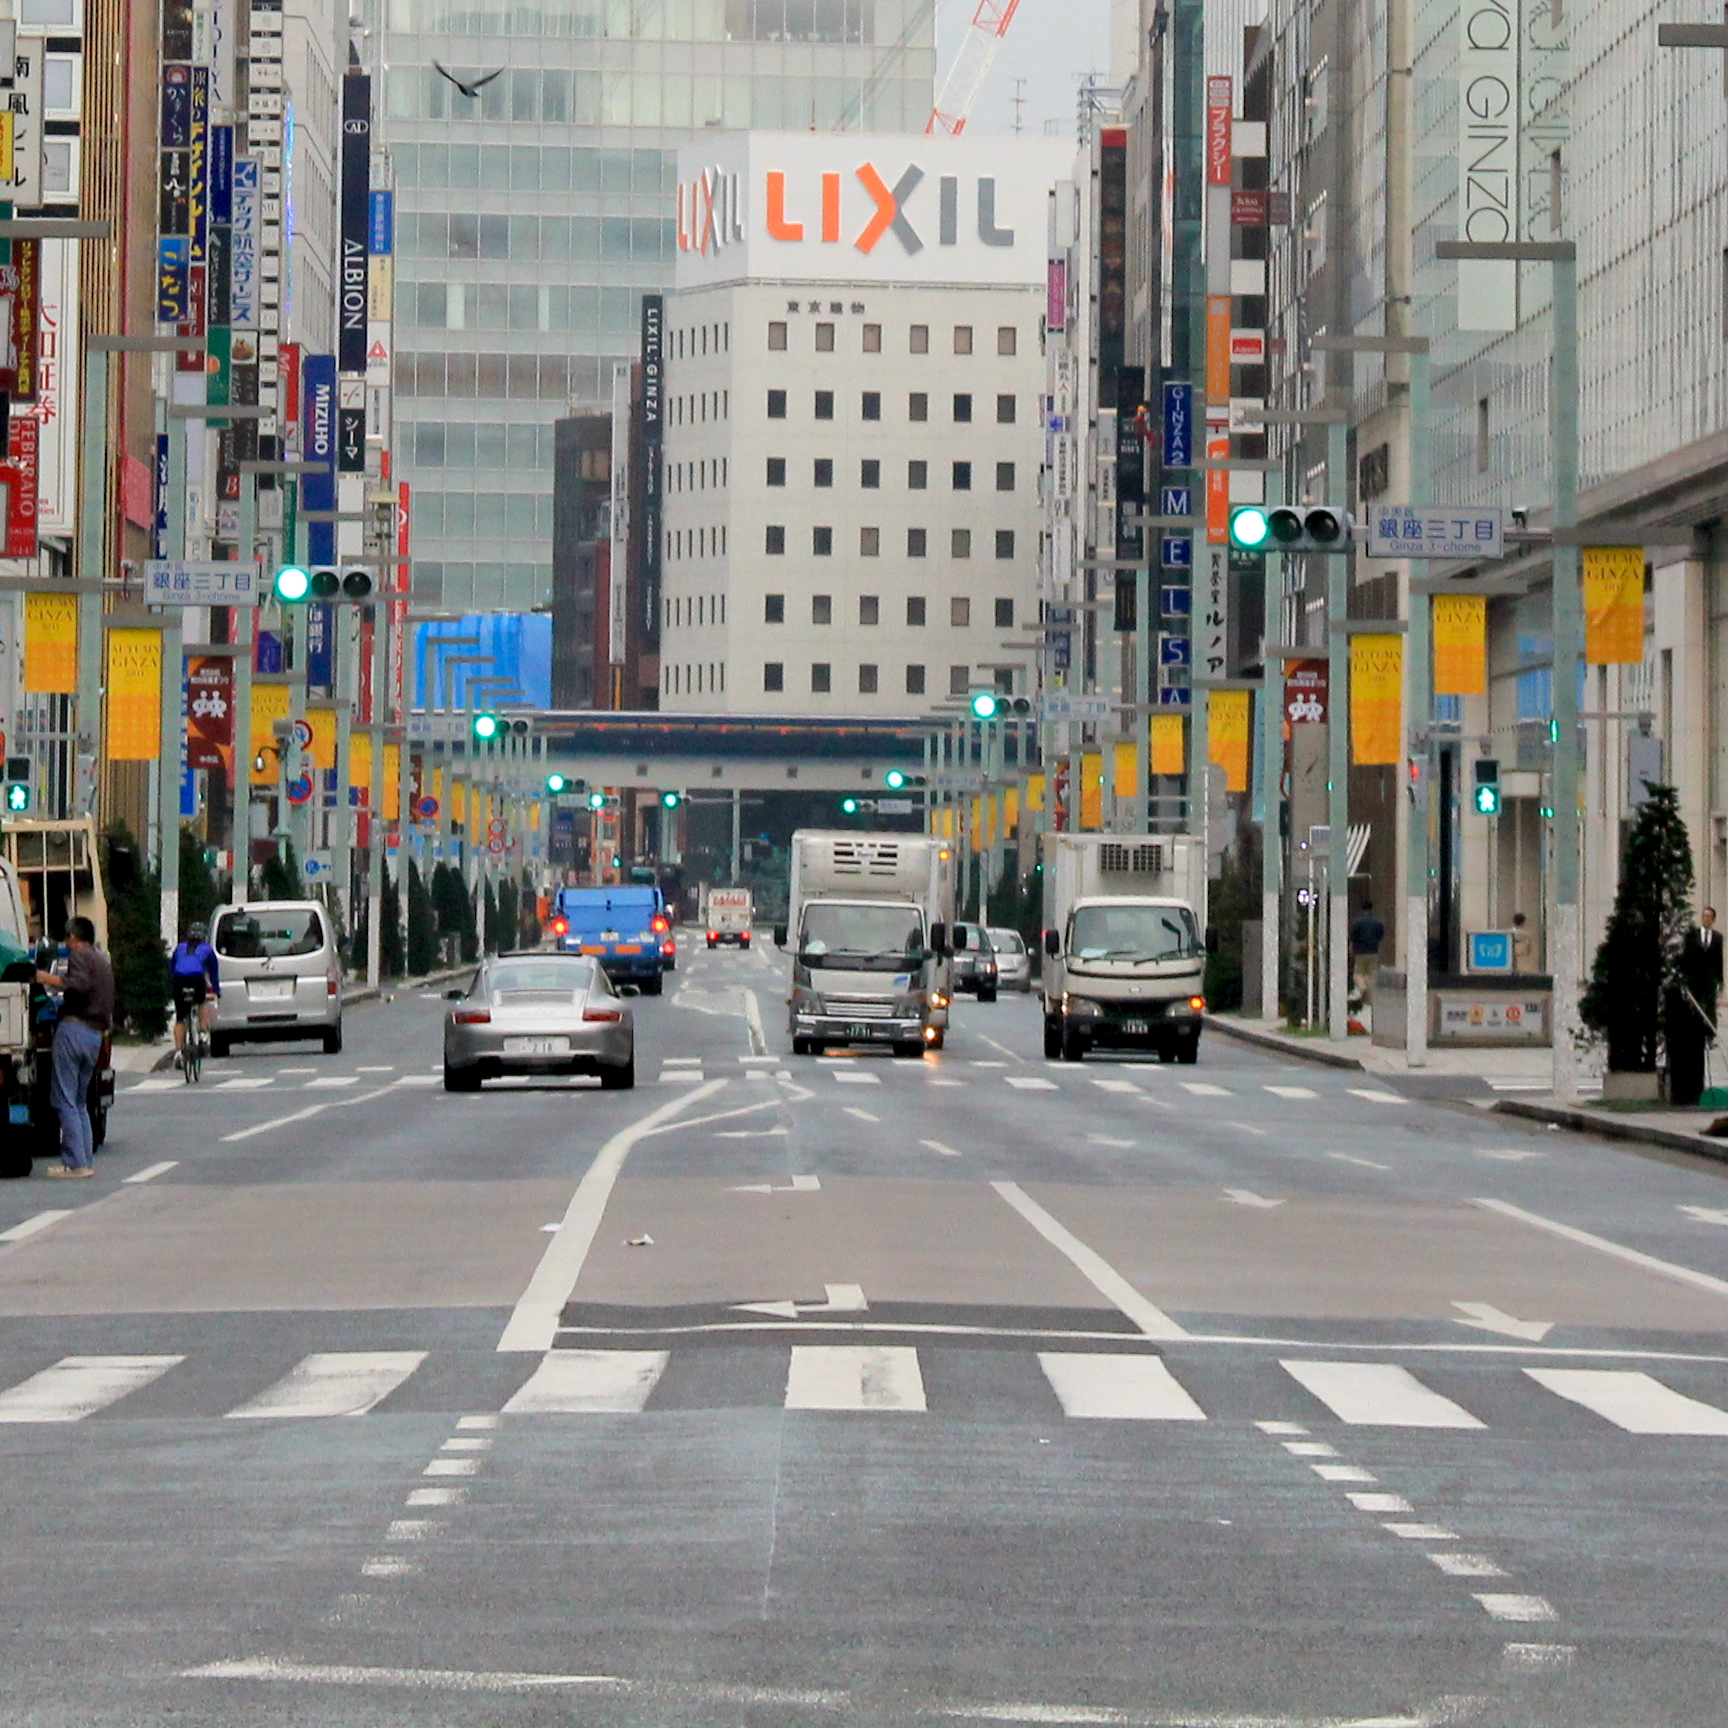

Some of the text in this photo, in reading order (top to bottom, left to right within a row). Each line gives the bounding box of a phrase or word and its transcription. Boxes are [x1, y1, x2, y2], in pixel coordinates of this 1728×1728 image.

[677, 163, 743, 257] LIXIL
[765, 161, 1015, 257] LIXIL
[343, 237, 364, 331] ALBION
[315, 383, 331, 456] MIZUHO
[344, 416, 360, 461] シーマ
[18, 418, 35, 517] FEBBRAIO
[1378, 517, 1493, 540] 銀座三丁目
[152, 571, 251, 590] 銀座三丁目
[1586, 566, 1640, 580] GINZA
[28, 610, 73, 622] GINZA
[1436, 612, 1482, 624] GINZA
[111, 656, 158, 668] GINZA
[1352, 661, 1400, 673] GINZA
